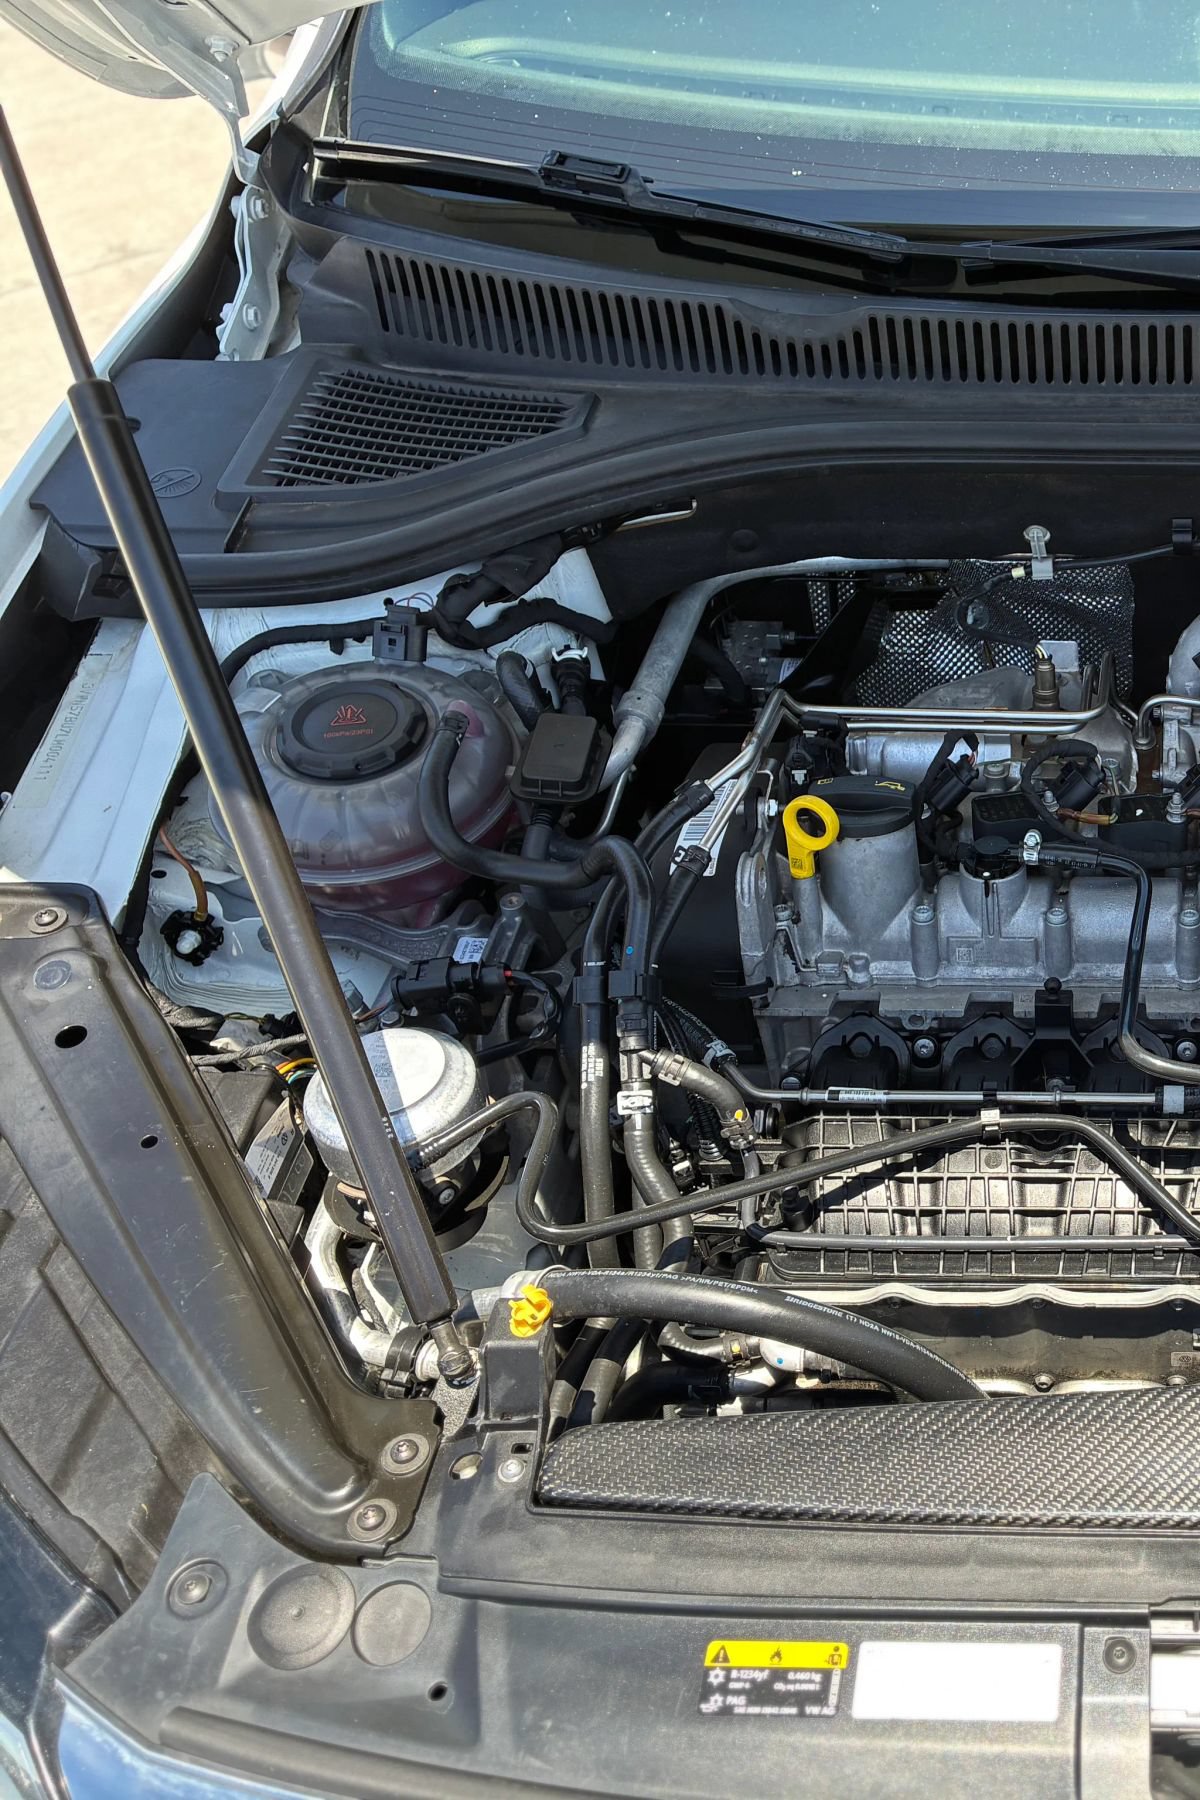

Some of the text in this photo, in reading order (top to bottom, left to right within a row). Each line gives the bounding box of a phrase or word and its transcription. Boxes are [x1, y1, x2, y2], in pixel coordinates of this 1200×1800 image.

[784, 1295, 843, 1317] BRIDGESTONE
[846, 1314, 857, 1323] (T)
[731, 1669, 769, 1682] R-1234yf
[726, 1695, 747, 1706] PAG
